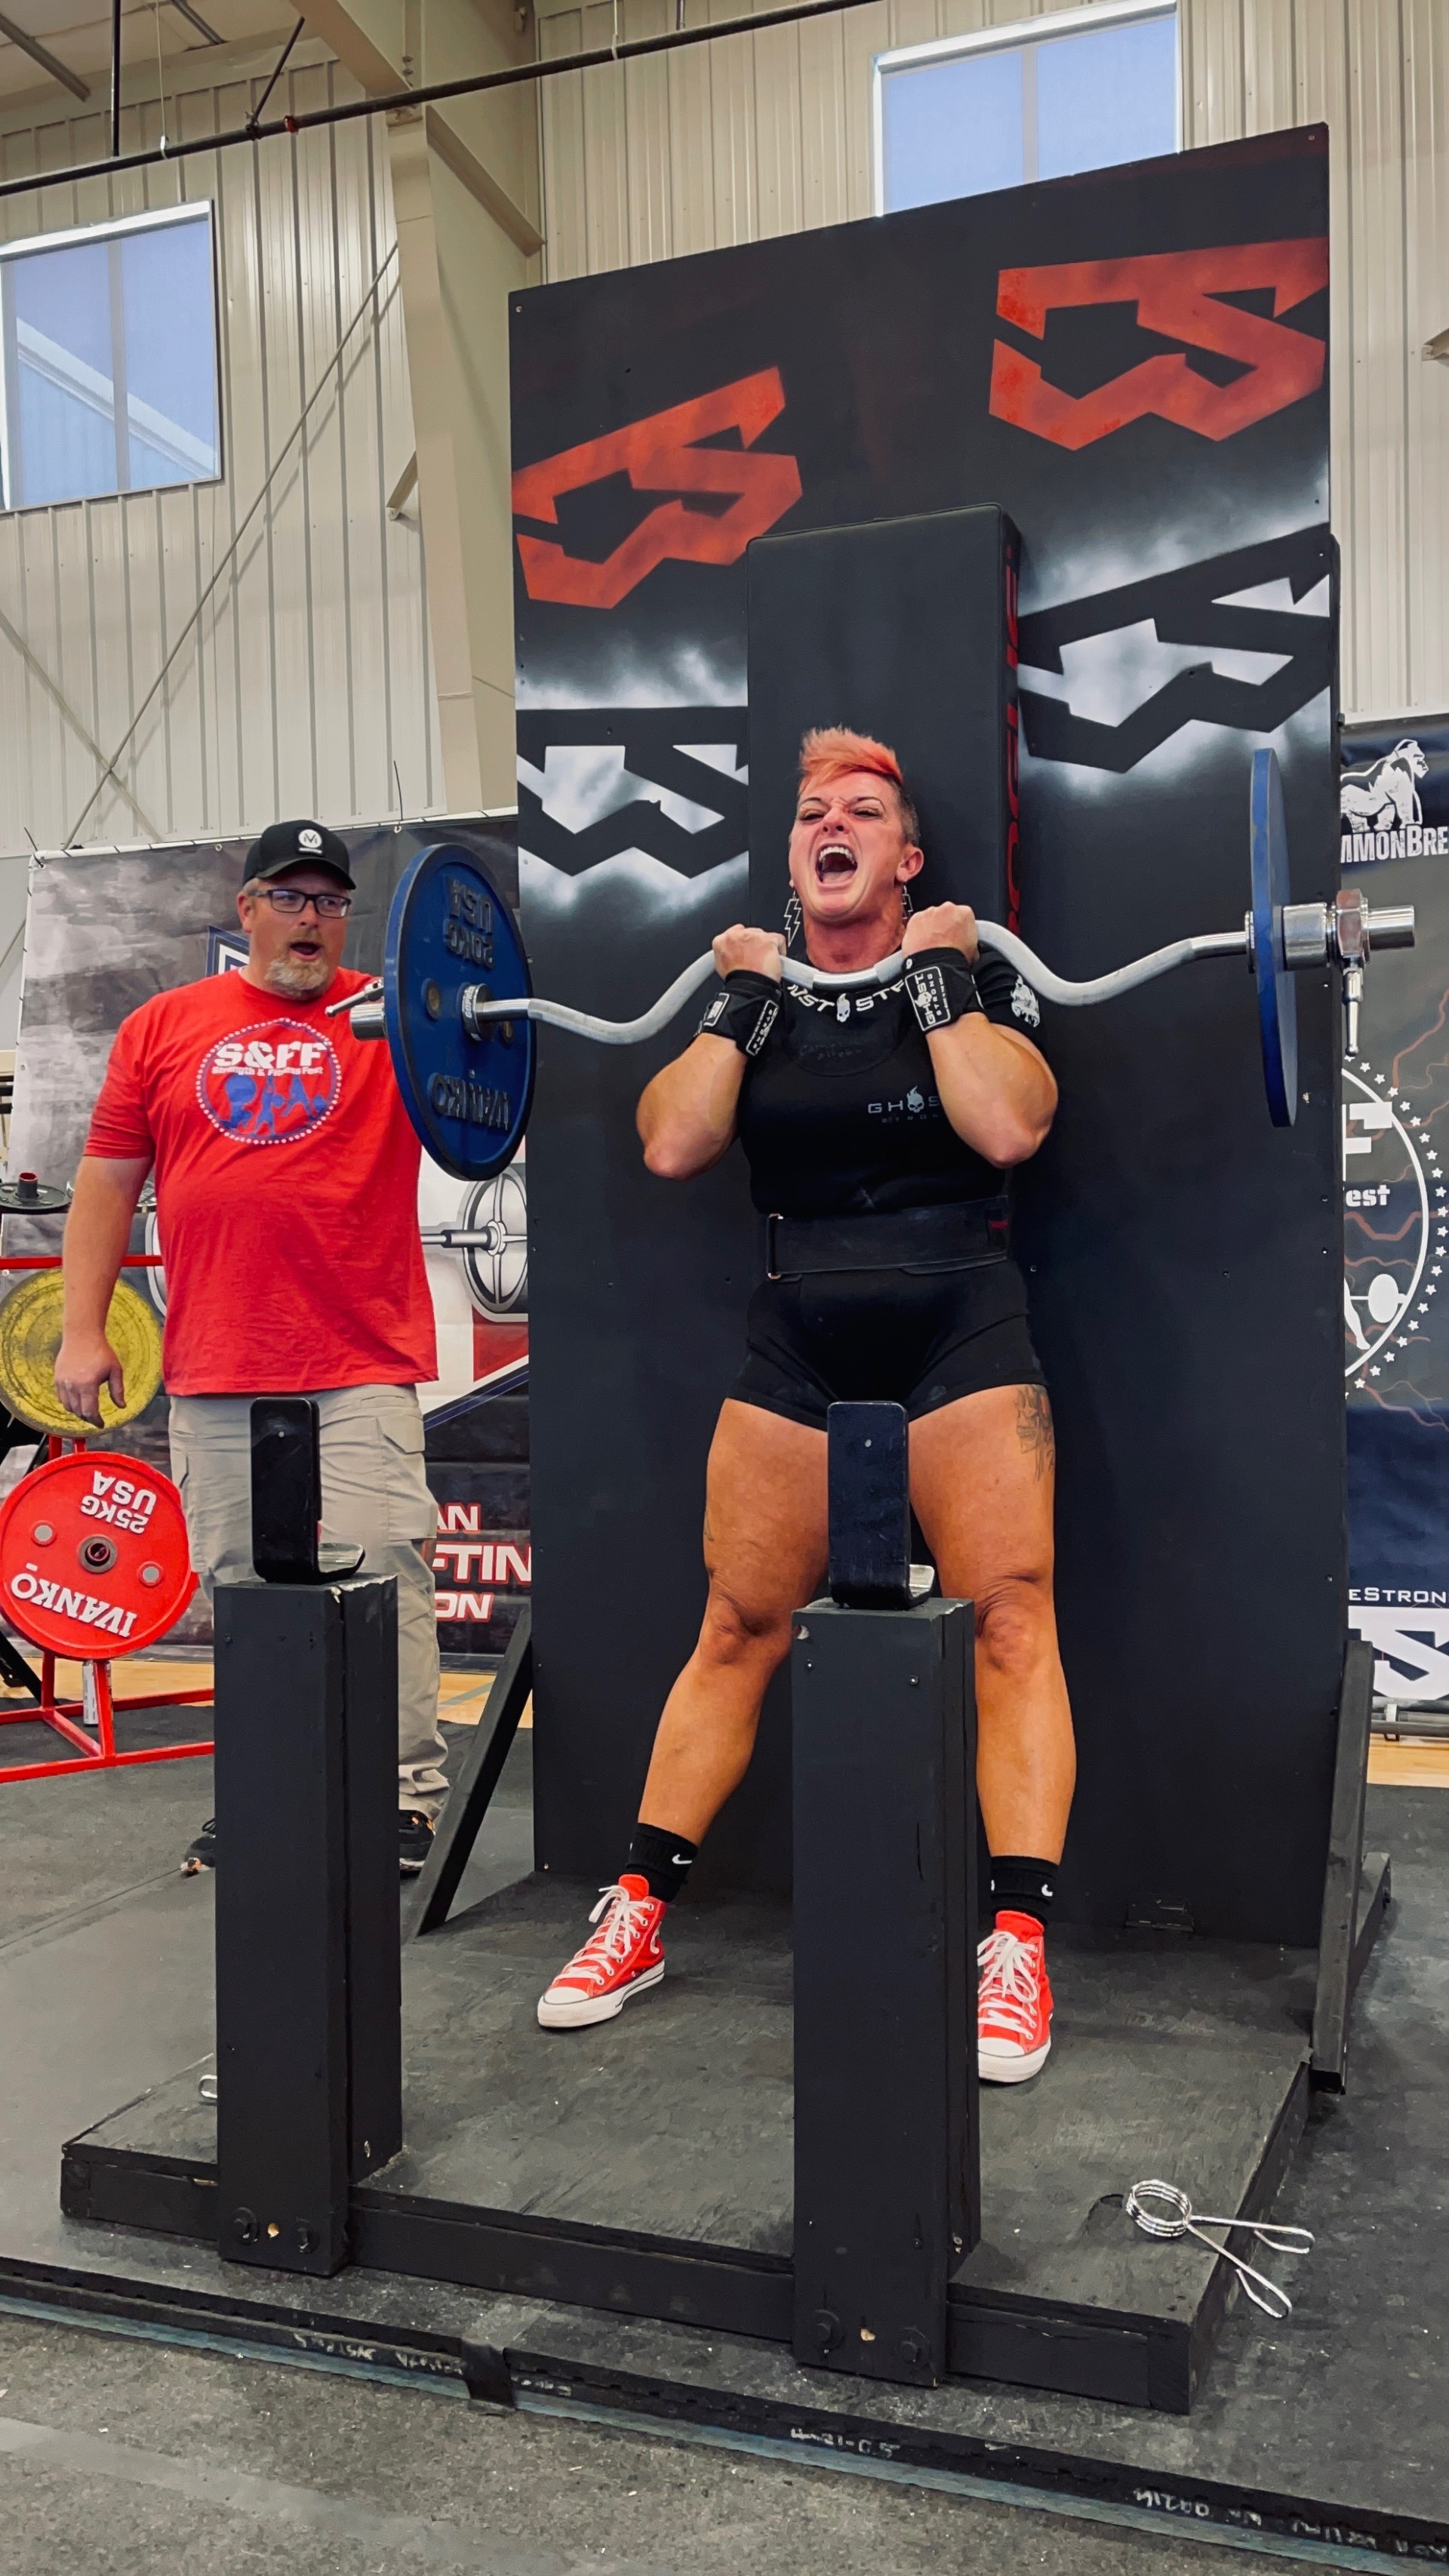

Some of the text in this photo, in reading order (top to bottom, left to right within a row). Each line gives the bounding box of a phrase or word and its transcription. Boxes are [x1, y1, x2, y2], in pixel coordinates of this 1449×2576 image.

[214, 1041, 328, 1069] S&FF
[92, 1470, 157, 1516] USA
[80, 1495, 149, 1534] 25KG
[11, 1567, 137, 1638] IVANKO
